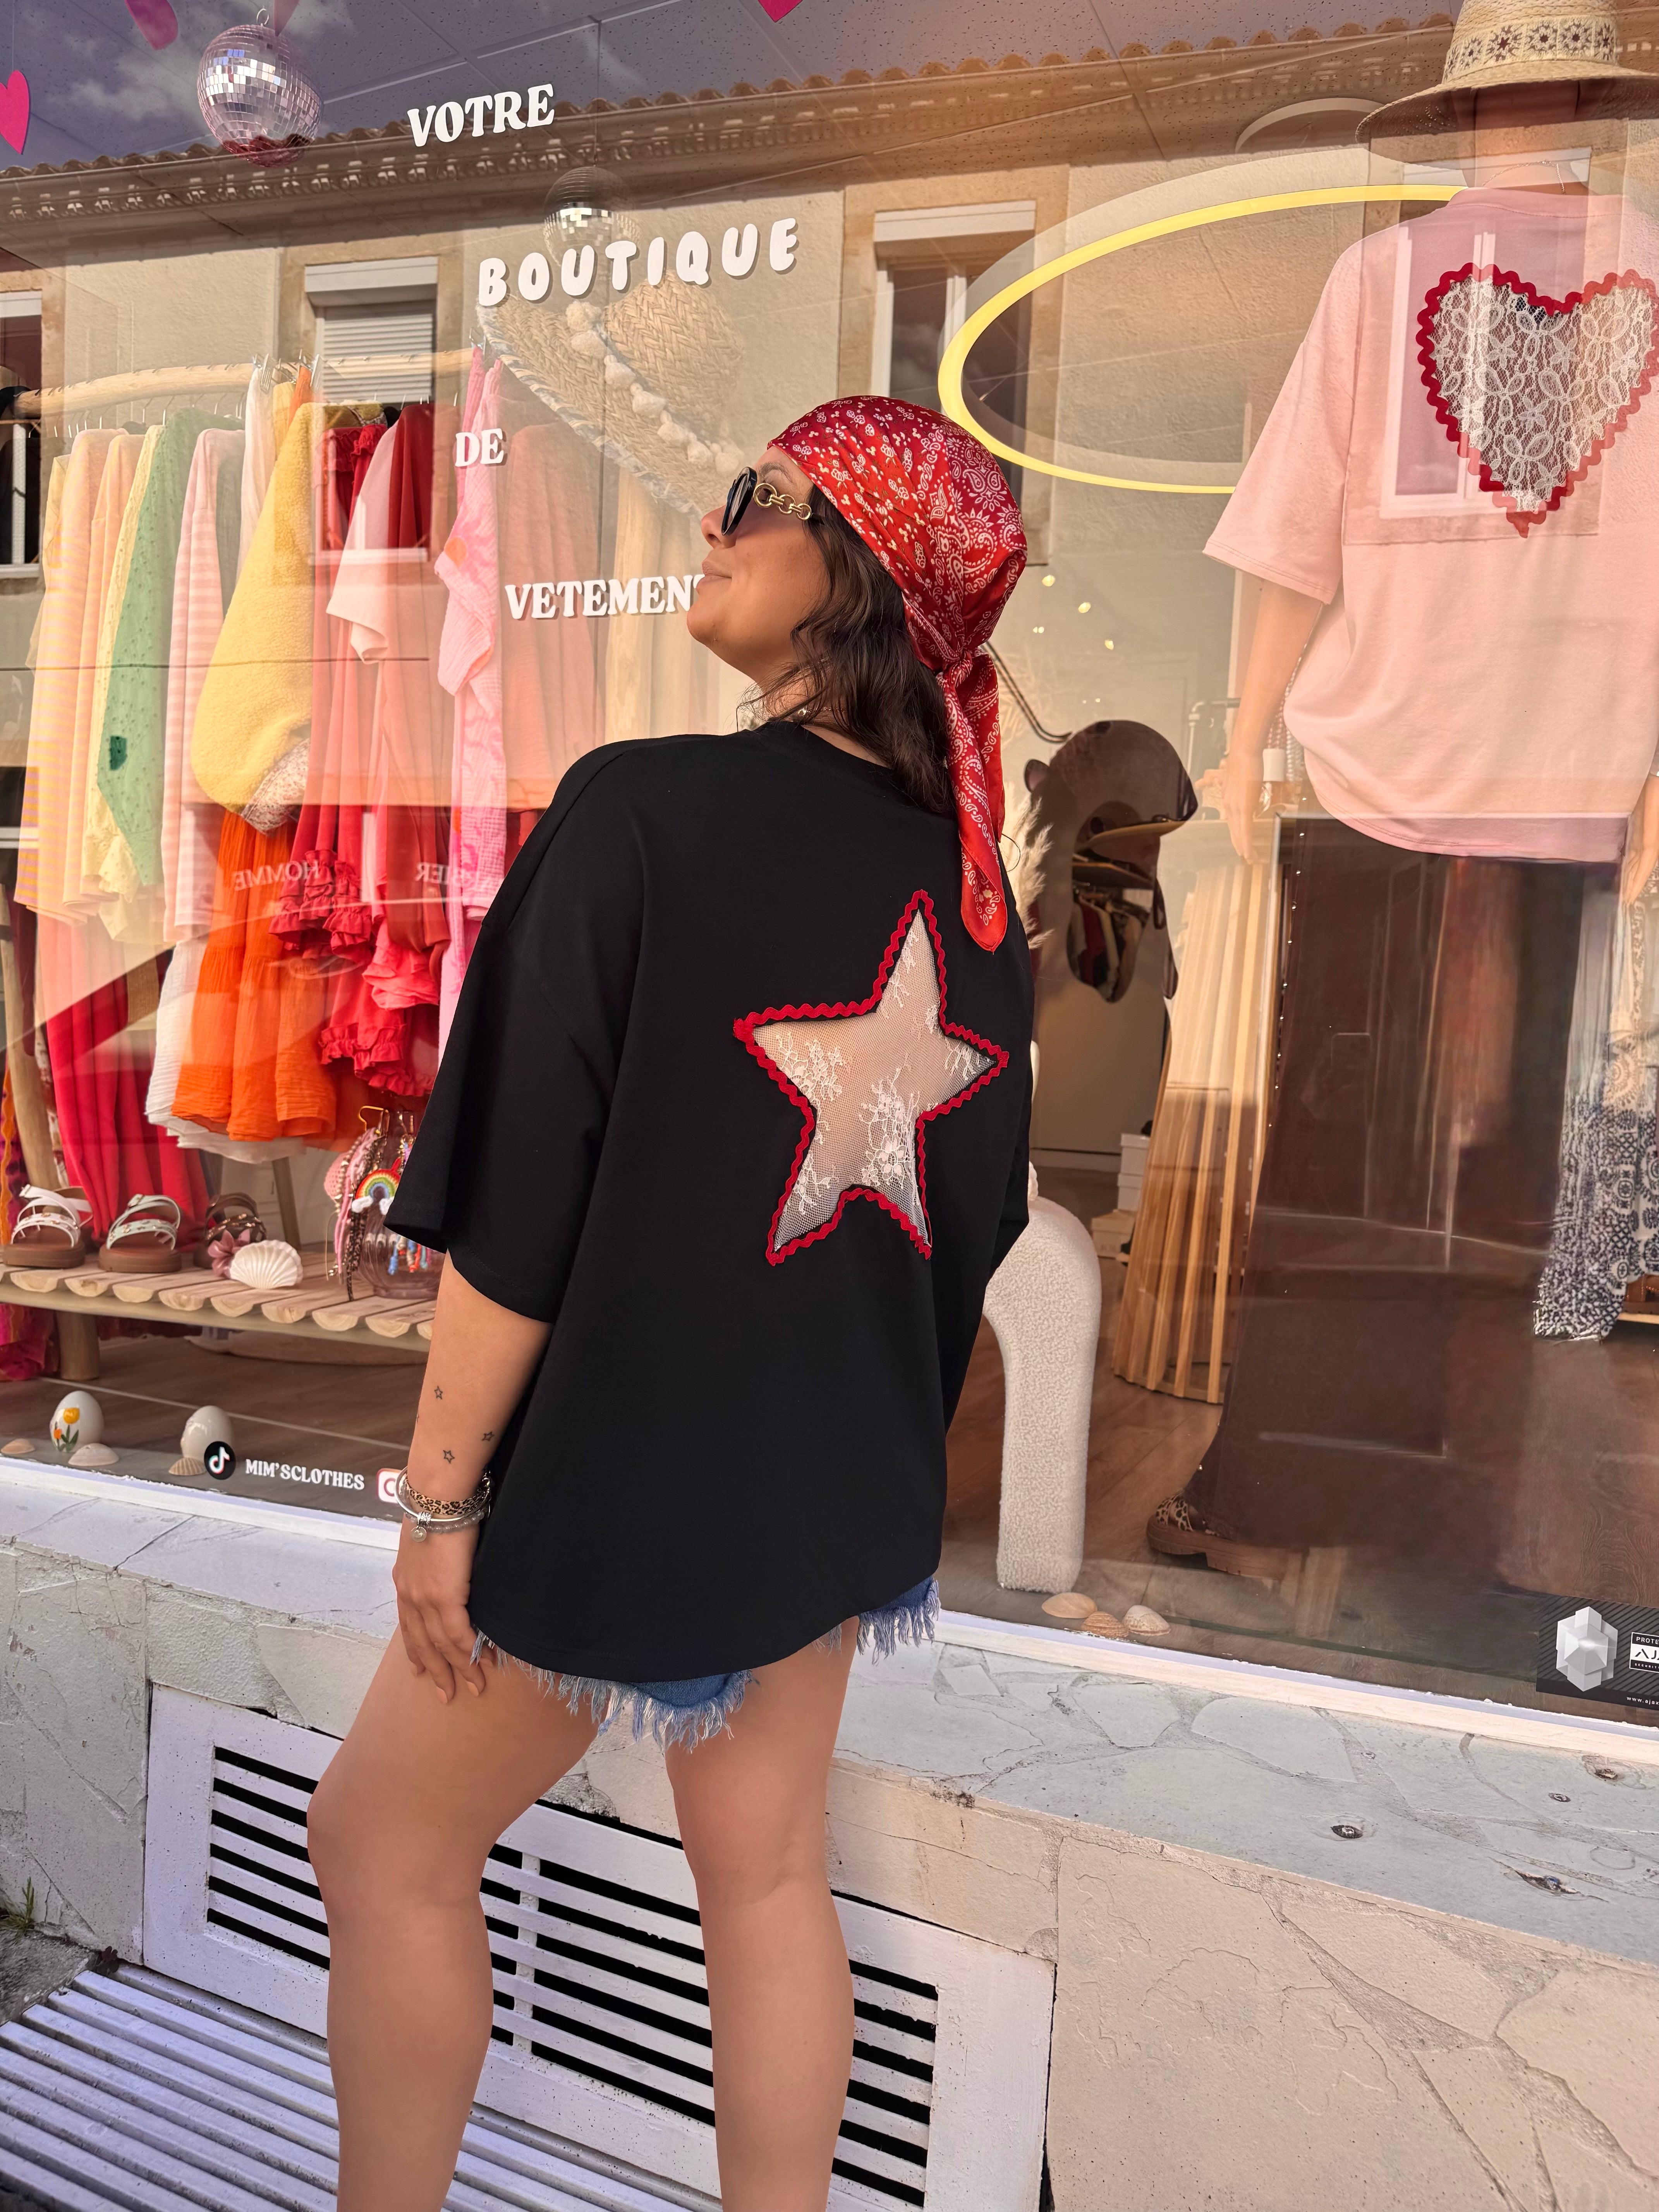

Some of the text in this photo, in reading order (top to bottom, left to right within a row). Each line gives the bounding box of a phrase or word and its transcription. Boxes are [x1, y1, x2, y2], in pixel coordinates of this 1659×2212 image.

[407, 83, 555, 147] VOTRE
[478, 218, 797, 306] BOUTIQUE
[455, 428, 505, 467] DE
[505, 574, 705, 619] VETEMEN
[245, 1458, 365, 1491] MIM'SCLOTHES
[1635, 1648, 1659, 1660] AJ
